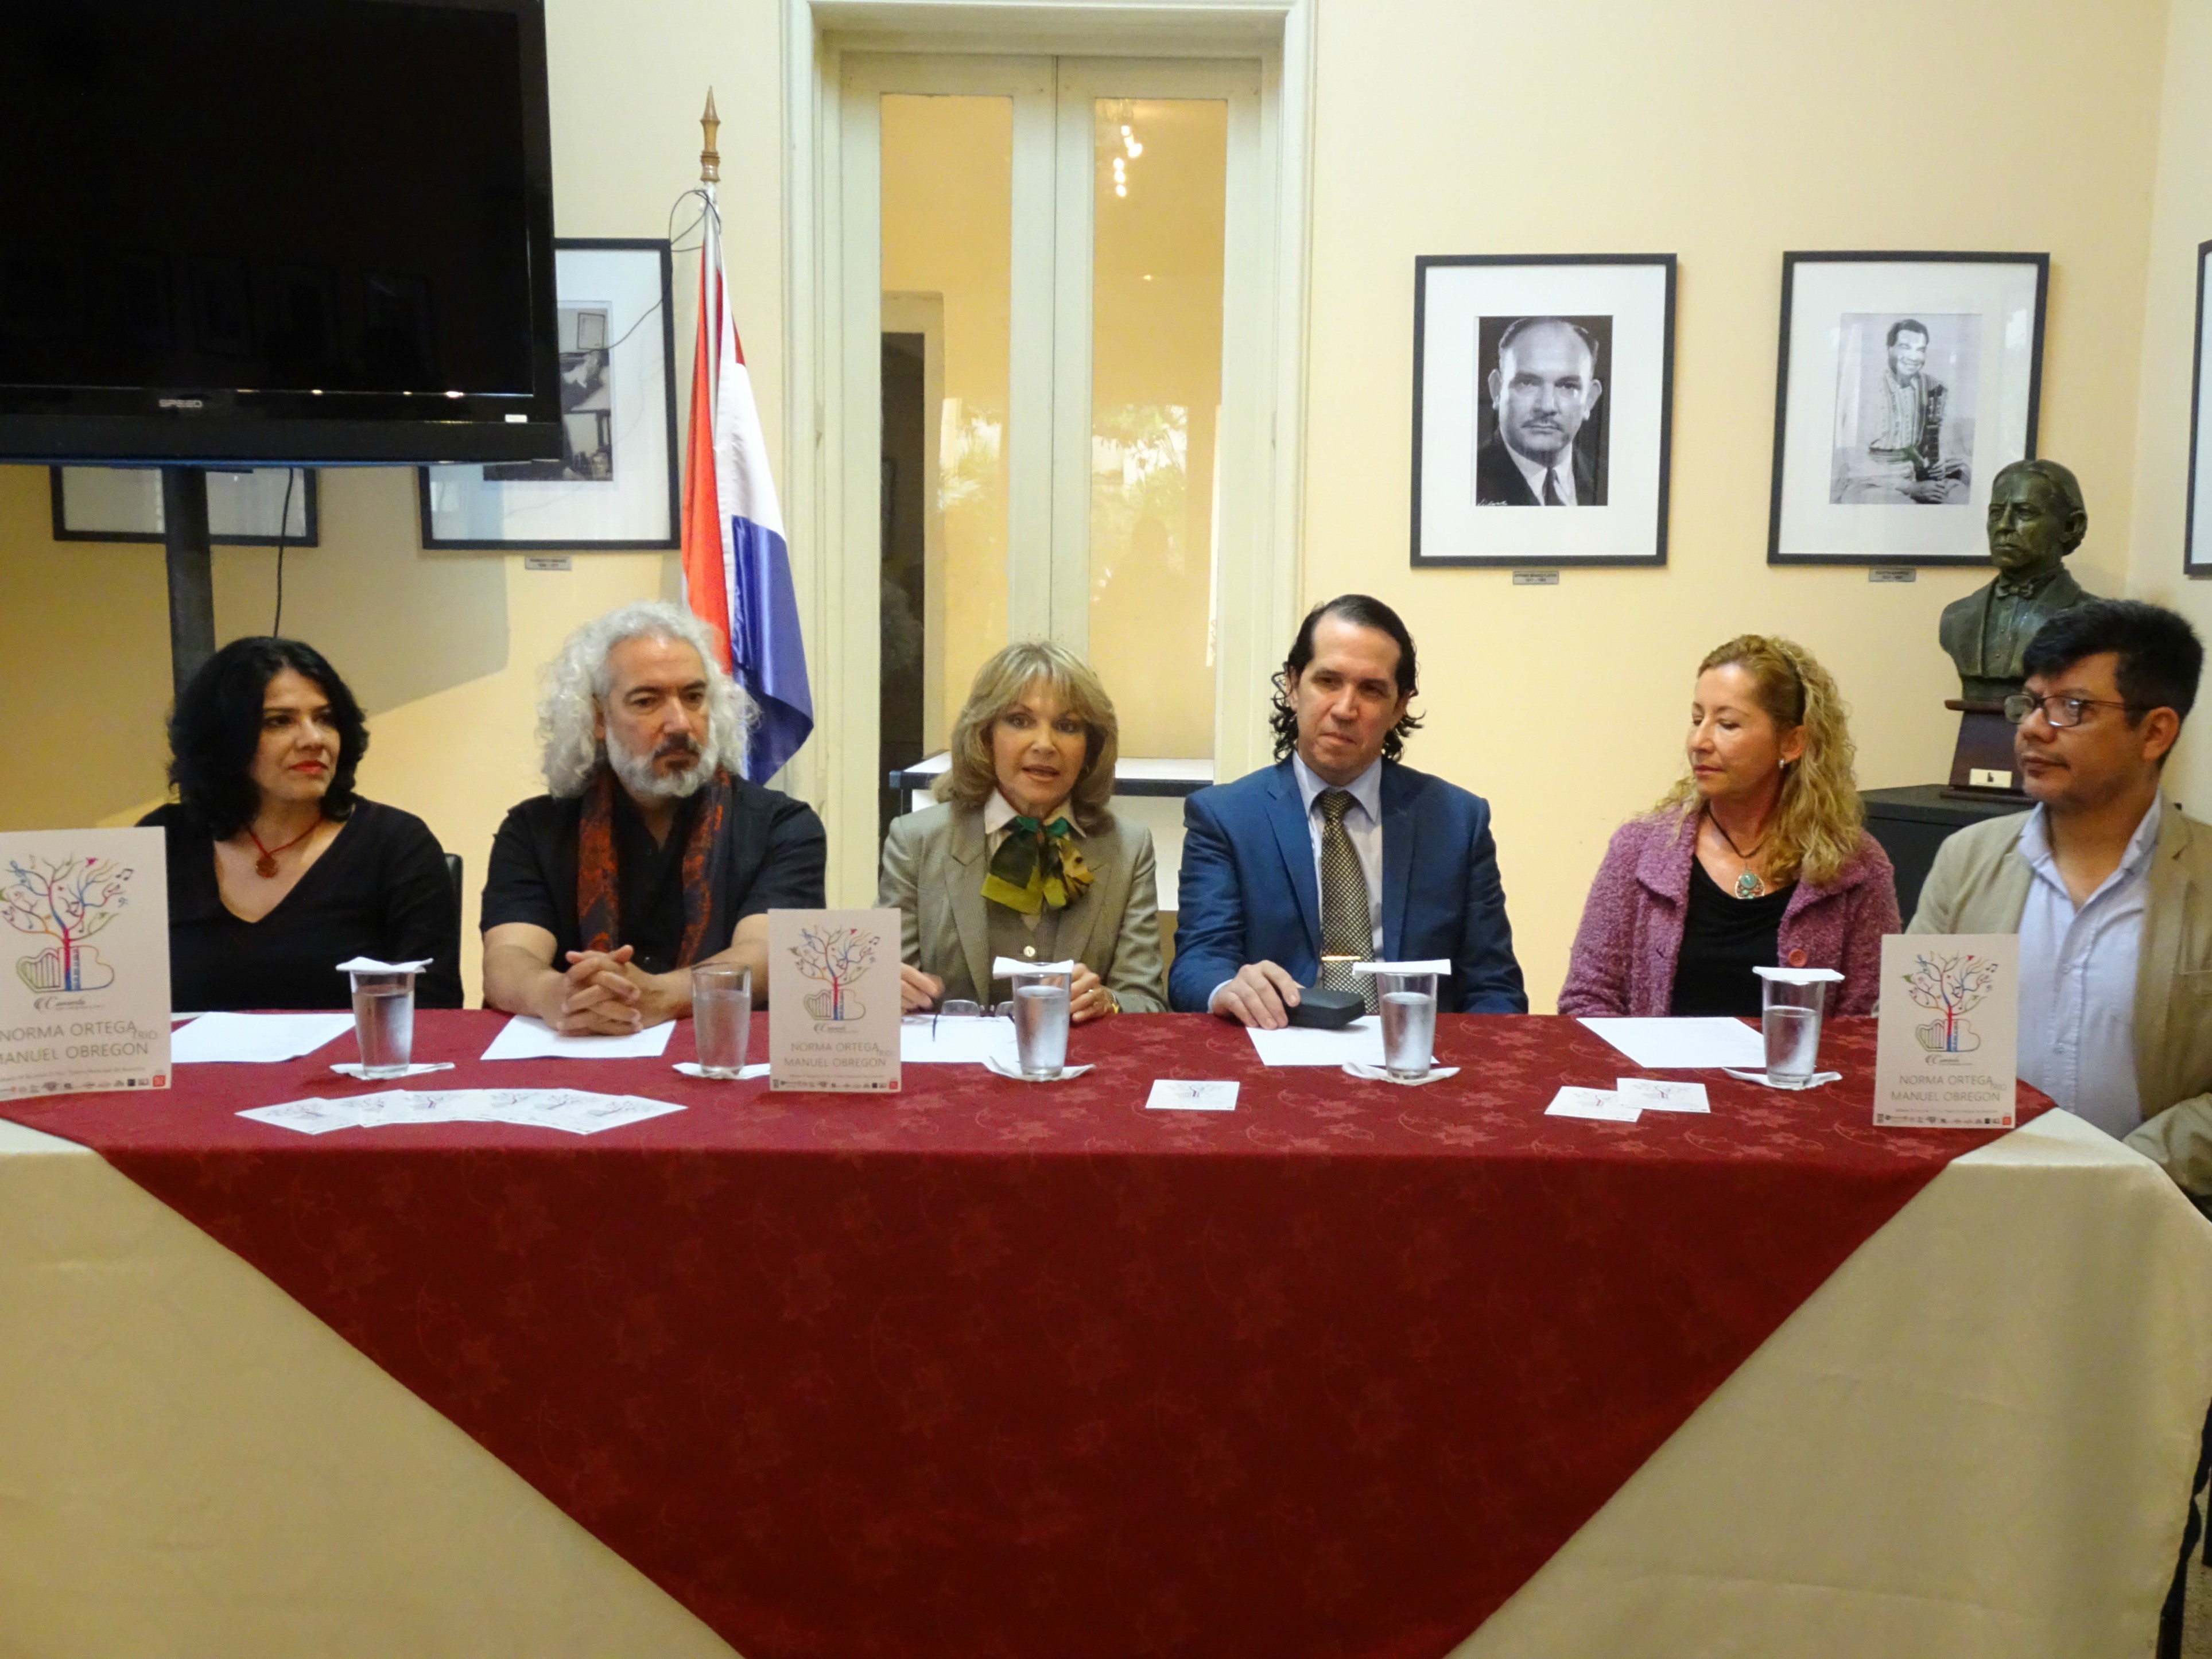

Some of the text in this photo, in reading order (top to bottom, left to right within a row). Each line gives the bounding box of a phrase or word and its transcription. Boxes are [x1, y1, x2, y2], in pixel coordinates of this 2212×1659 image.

[0, 1020, 137, 1042] NORMA ORTEGA
[66, 1043, 148, 1059] OBREGON
[791, 1042, 879, 1052] NORMA ORTEGA
[784, 1058, 886, 1067] MANUEL OBREGON
[1900, 1075, 1993, 1085] NORMA ORTEGA
[1891, 1091, 2000, 1102] MANUEL OBREGON
